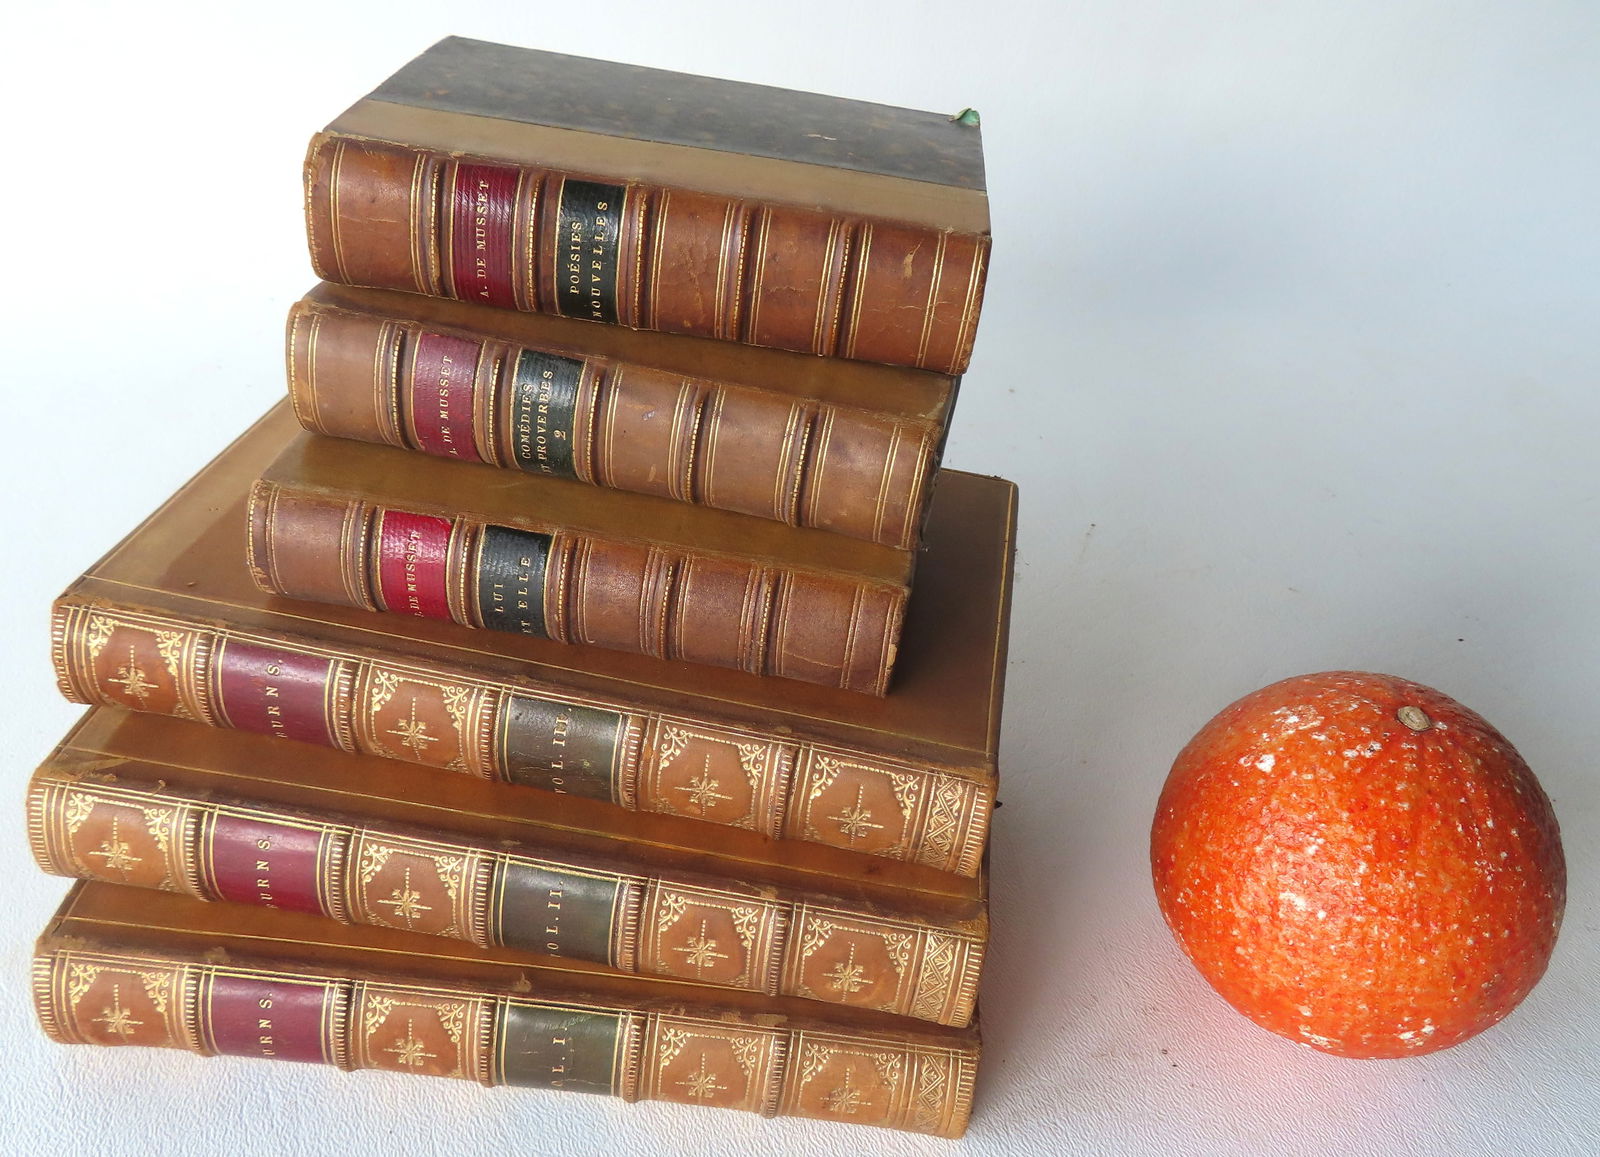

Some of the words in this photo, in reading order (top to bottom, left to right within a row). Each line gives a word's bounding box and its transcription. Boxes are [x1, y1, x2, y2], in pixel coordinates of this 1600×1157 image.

[477, 180, 489, 249] MUSSET
[477, 258, 487, 279] DE
[567, 221, 582, 295] POÉSIES
[592, 201, 608, 317] NOUVELLES
[479, 286, 489, 298] A.
[440, 356, 453, 420] MUSSET
[536, 370, 553, 461] PROVERBES
[440, 426, 452, 443] DE
[517, 383, 534, 459] COMÉDIES
[554, 430, 566, 441] 2
[406, 530, 421, 592] MUSSET
[518, 557, 530, 610] ELLE
[410, 596, 420, 610] DE
[494, 584, 504, 613] LUI
[258, 993, 275, 1056] URNS.
